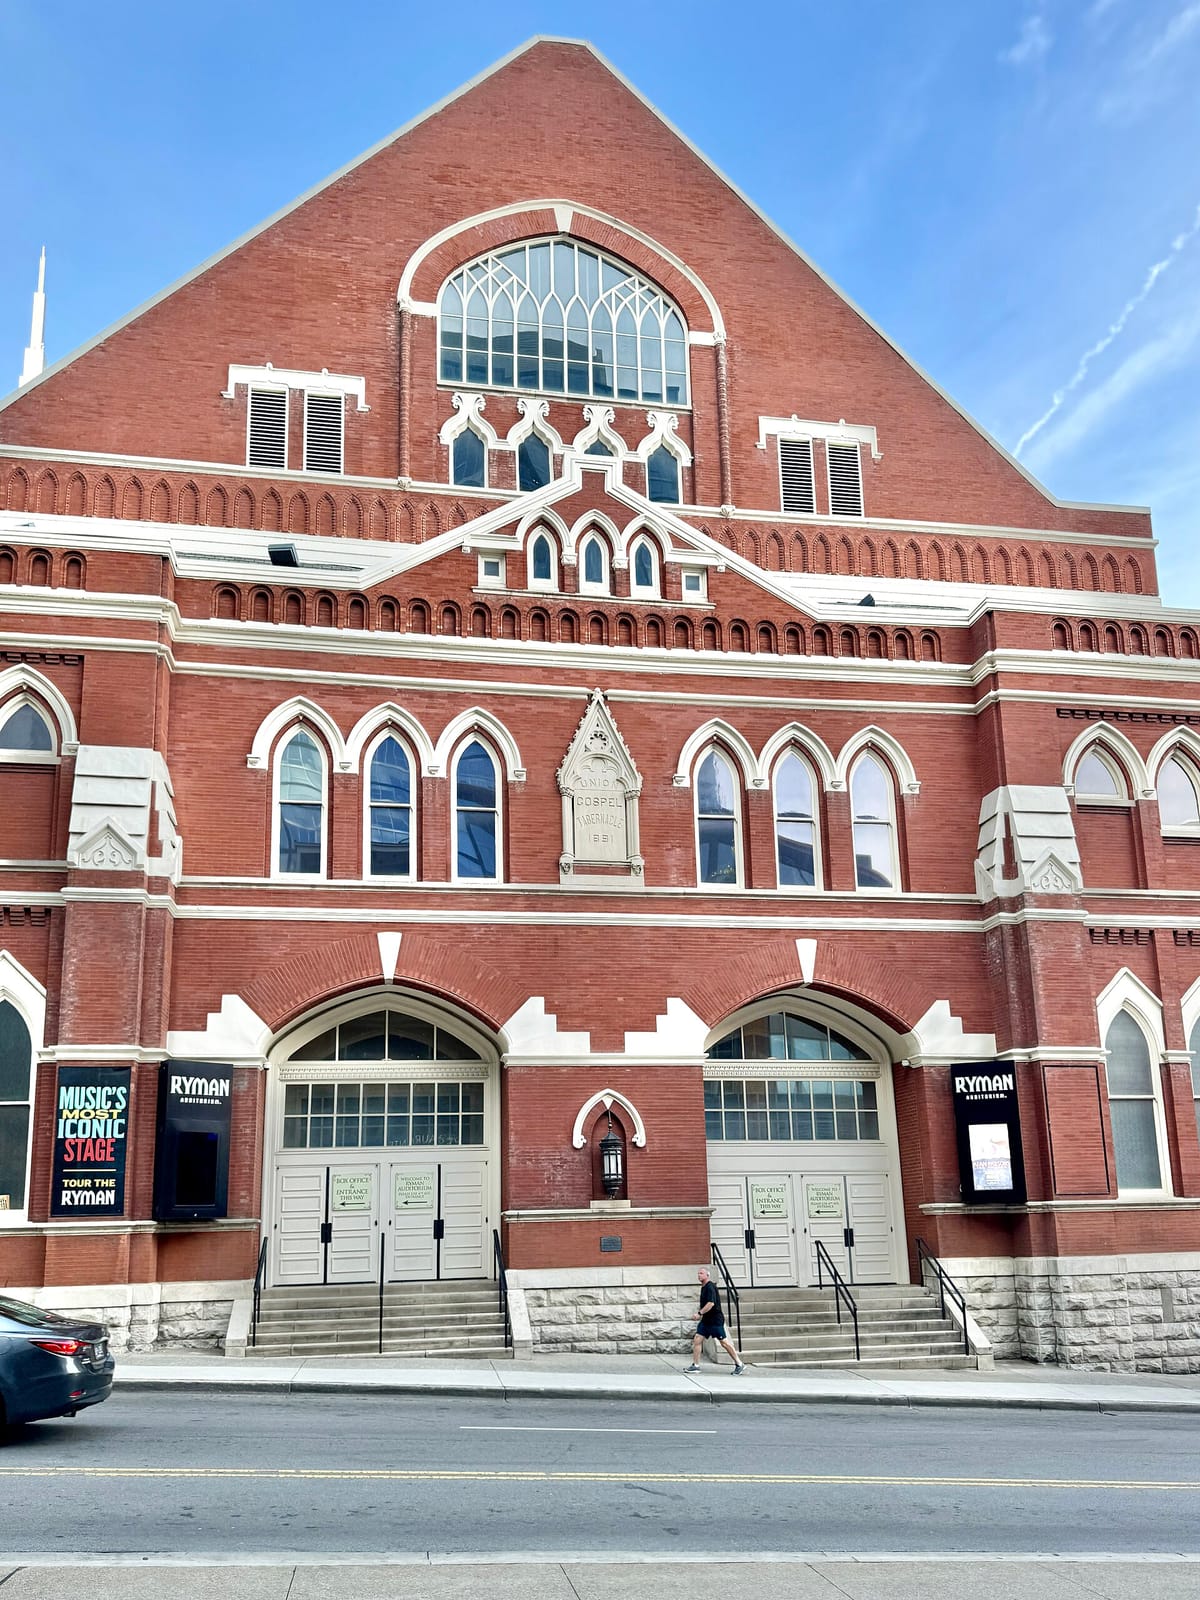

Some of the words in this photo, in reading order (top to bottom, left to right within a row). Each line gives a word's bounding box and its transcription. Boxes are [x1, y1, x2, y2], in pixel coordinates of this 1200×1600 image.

[576, 797, 622, 808] GOSPEL
[576, 812, 624, 829] TABERNACLE
[170, 1075, 230, 1097] RYMAN
[954, 1074, 1014, 1093] RYMAN
[58, 1086, 127, 1110] MUSIC'S
[62, 1109, 122, 1120] MOST
[57, 1118, 126, 1139] ICONIC
[63, 1138, 117, 1162] STAGE
[62, 1179, 92, 1188] TOUR
[94, 1179, 117, 1188] THE
[60, 1189, 116, 1207] RYMAN
